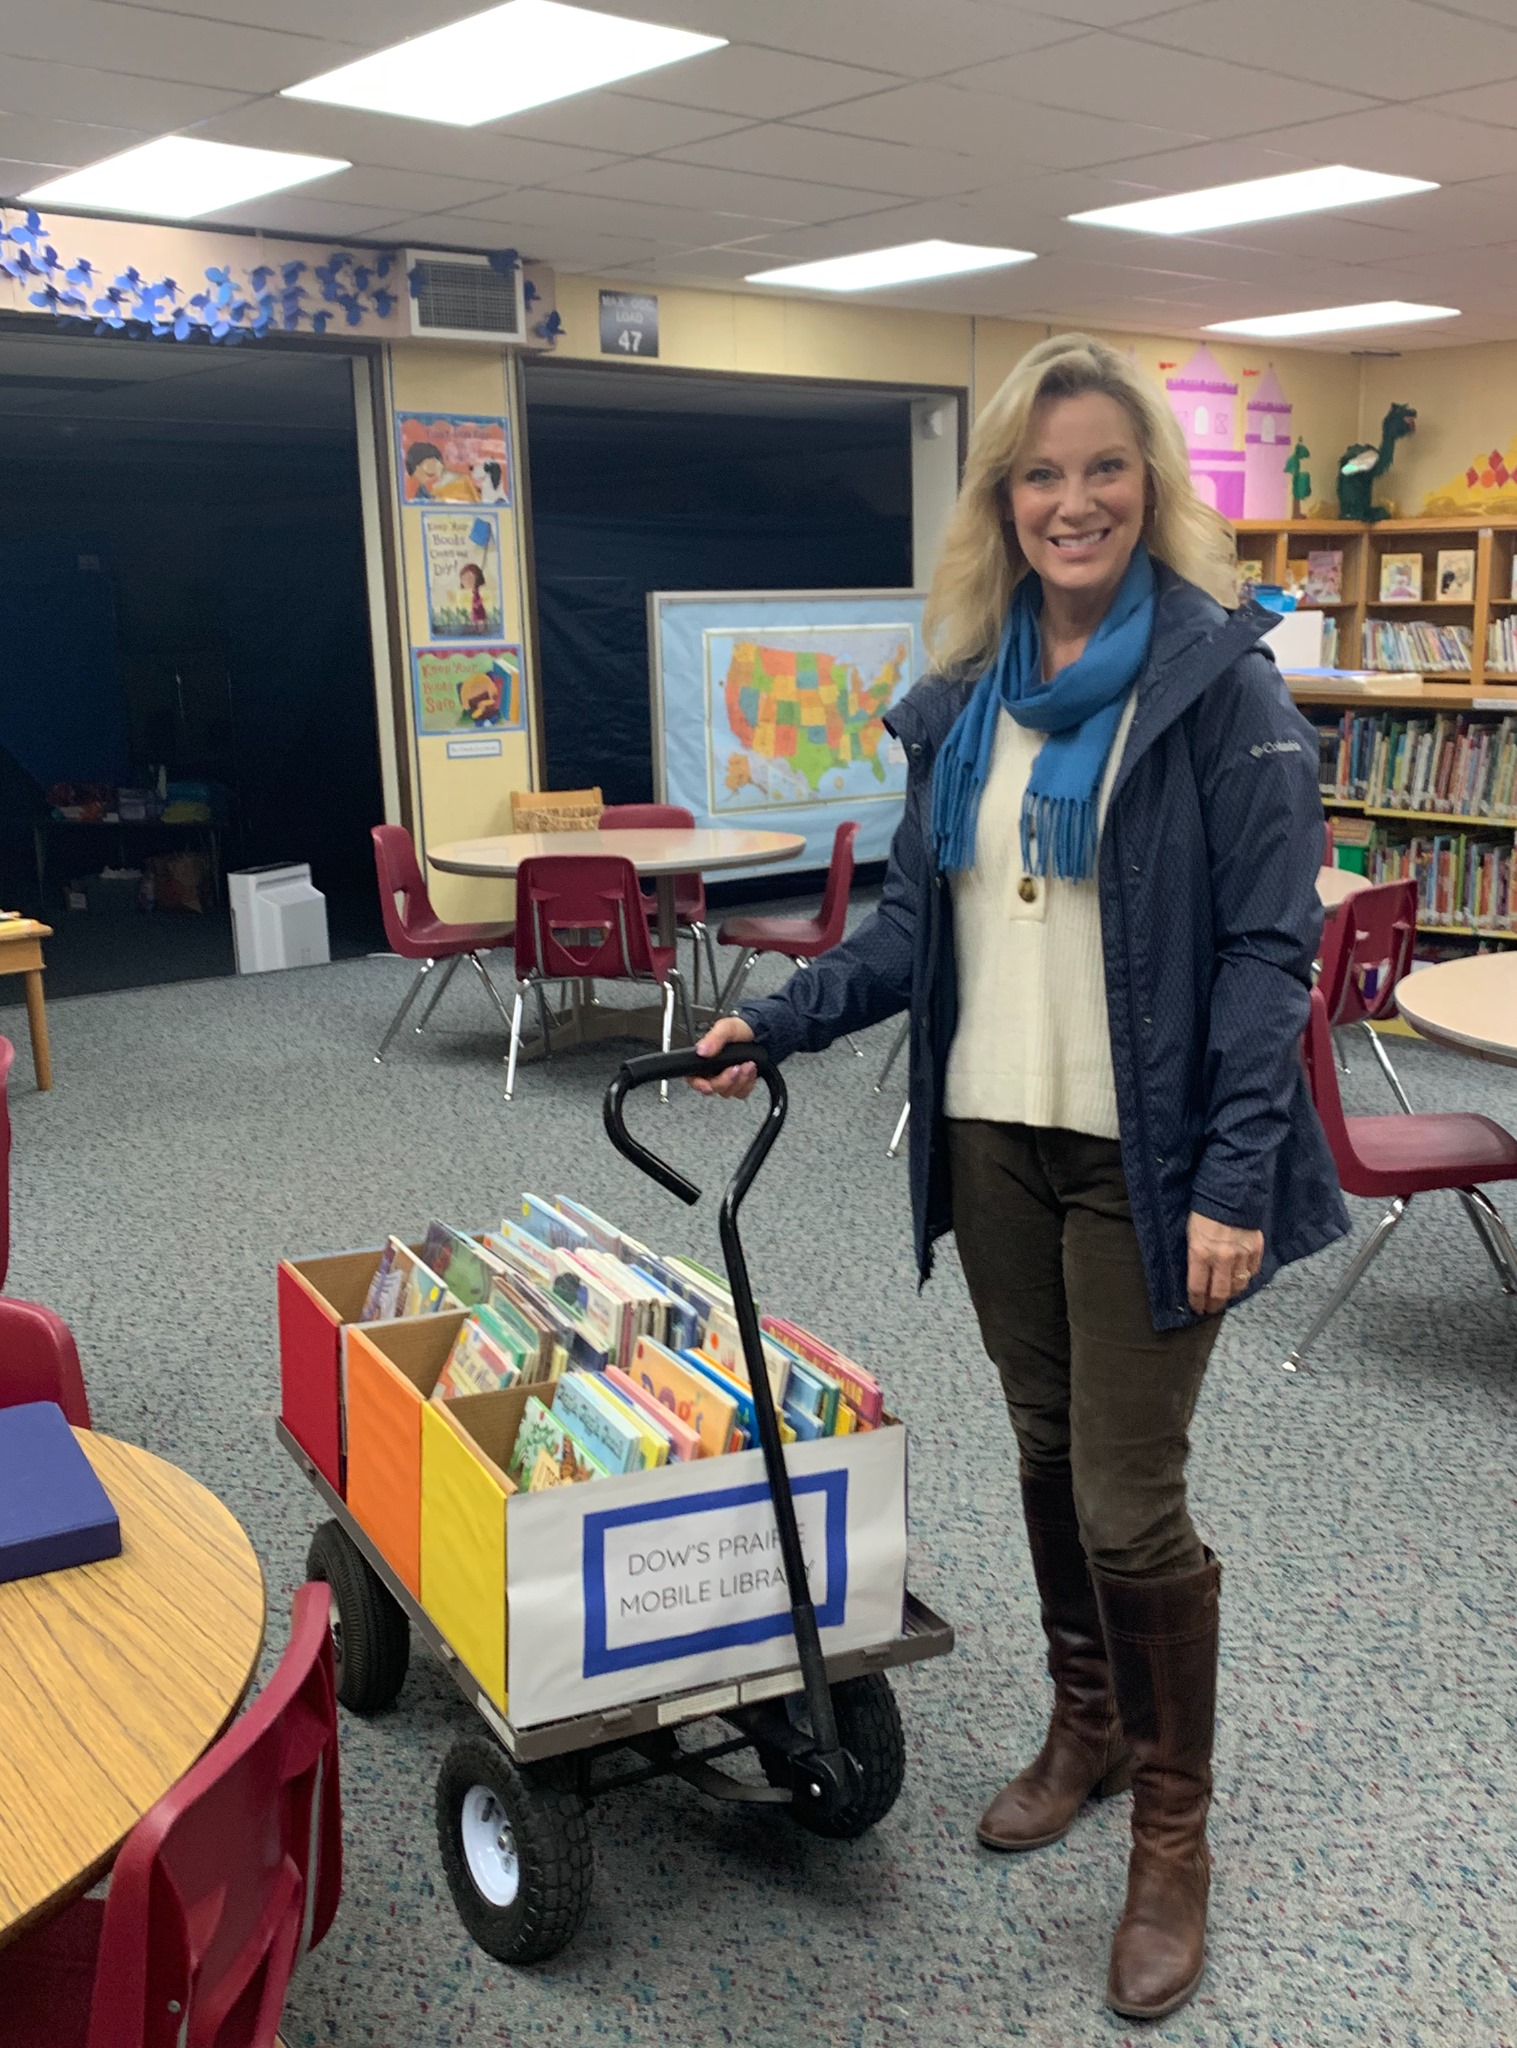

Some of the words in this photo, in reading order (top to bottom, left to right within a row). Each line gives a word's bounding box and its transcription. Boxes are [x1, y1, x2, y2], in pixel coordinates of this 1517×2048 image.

[616, 311, 643, 324] LOAD
[618, 329, 643, 353] 47
[432, 533, 466, 546] Books
[422, 664, 451, 678] Keep
[628, 1542, 711, 1576] DOW'S
[620, 1580, 712, 1617] MOBILE
[720, 1559, 816, 1599] LIBRAY
